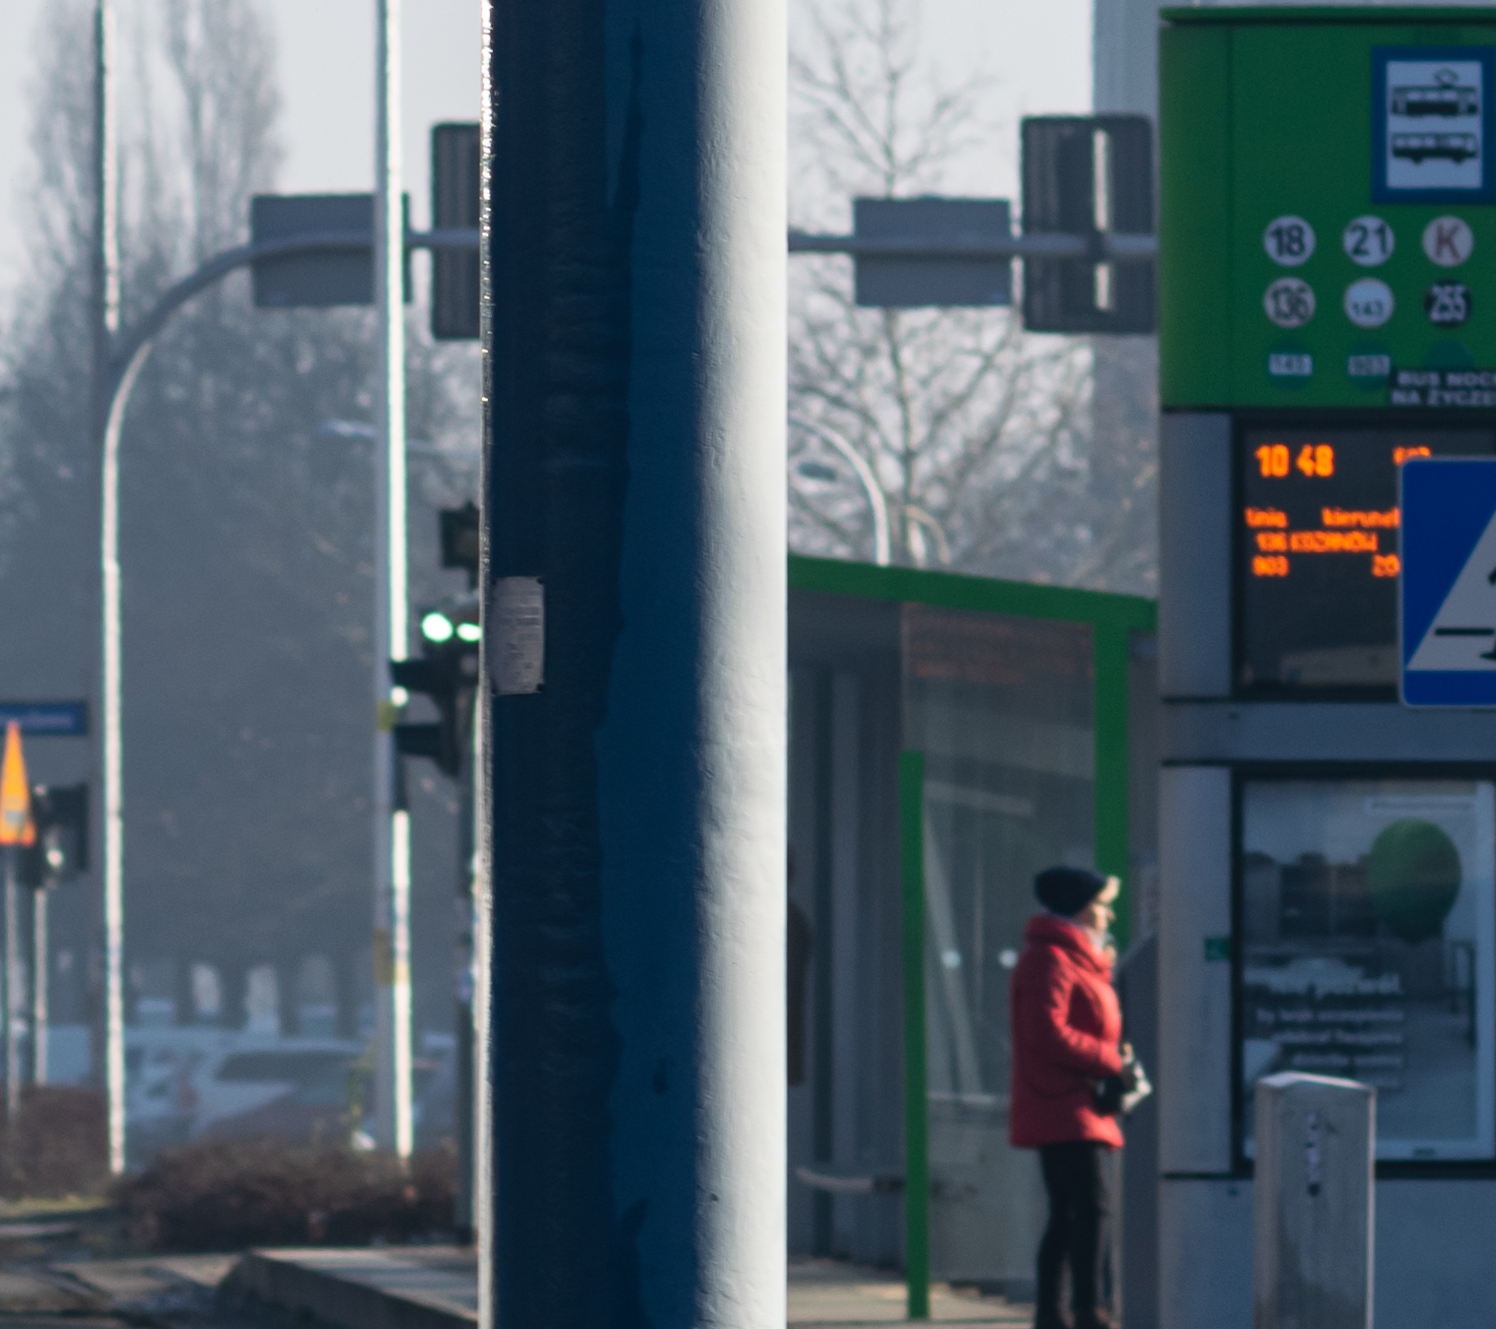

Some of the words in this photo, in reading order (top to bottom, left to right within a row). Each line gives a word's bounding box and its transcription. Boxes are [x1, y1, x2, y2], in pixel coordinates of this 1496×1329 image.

[1270, 223, 1306, 258] 18
[1349, 223, 1387, 257] 21
[1434, 223, 1460, 261] K
[1255, 443, 1290, 478] 10
[1296, 443, 1335, 478] 48
